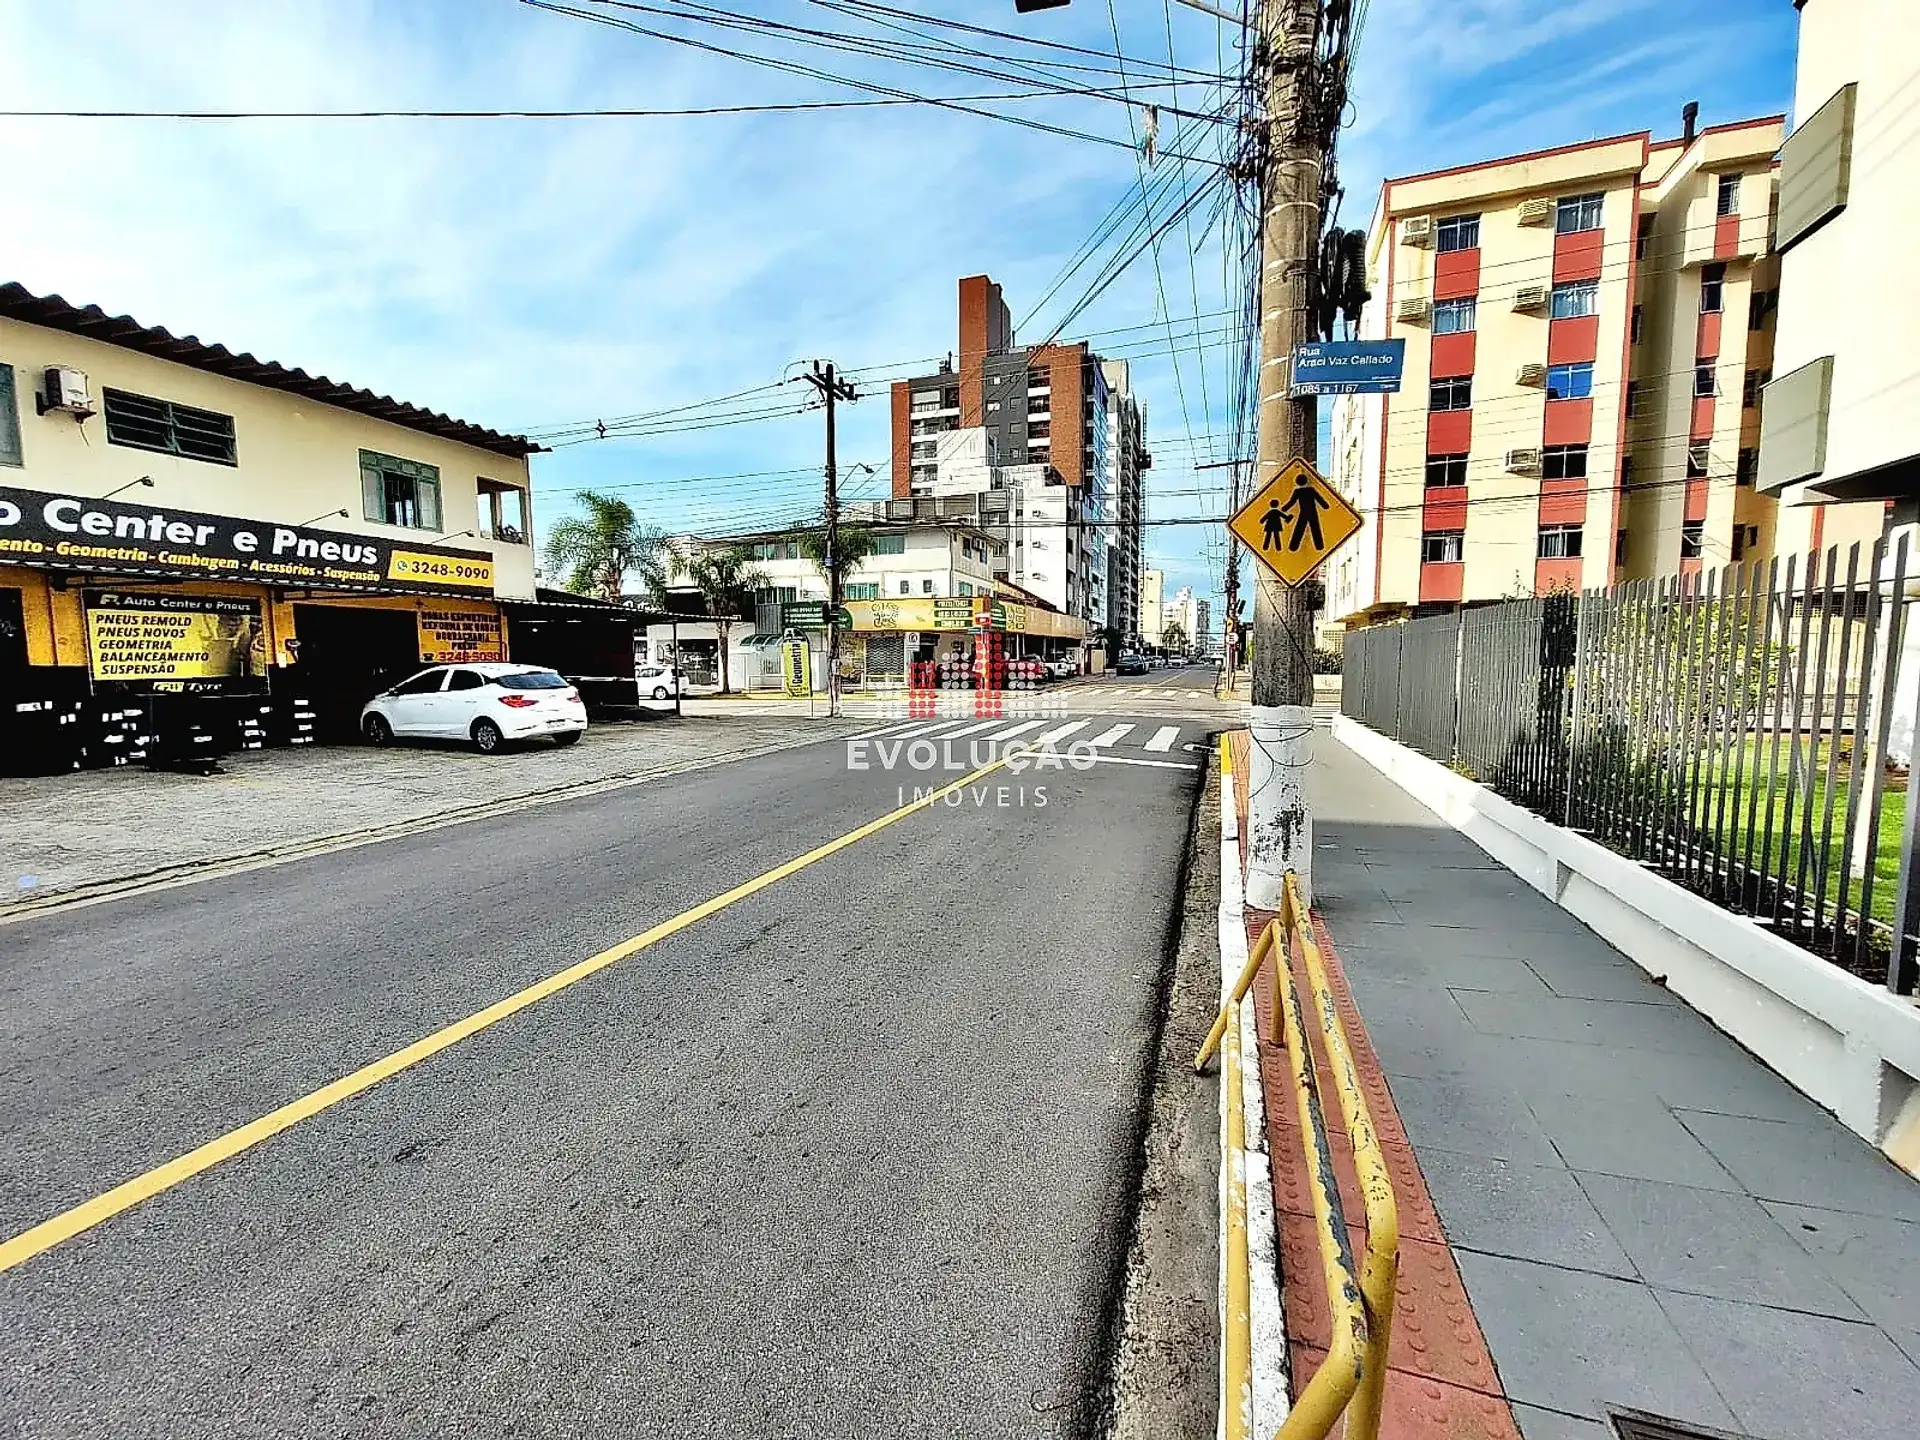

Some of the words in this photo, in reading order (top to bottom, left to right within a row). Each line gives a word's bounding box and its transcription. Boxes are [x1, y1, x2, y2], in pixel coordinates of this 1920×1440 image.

[1299, 347, 1321, 357] Rua
[1298, 357, 1326, 368] Araci
[1328, 356, 1348, 366] Vaz
[1322, 386, 1330, 394] a
[43, 499, 216, 546] Center
[232, 530, 259, 552] e
[272, 527, 378, 565] Pneus
[158, 550, 239, 571] Cambagem
[249, 559, 316, 576] Acessórios
[323, 566, 380, 582] Suspensão
[411, 561, 490, 580] 3248-9090
[123, 596, 156, 606] Auto
[160, 597, 202, 609] Center
[205, 601, 213, 609] e
[216, 601, 251, 611] Pneus
[96, 614, 139, 625] PNEUS
[141, 615, 192, 627] REMOLD
[97, 627, 140, 638] PNEUS
[142, 628, 187, 638] NOVOS
[98, 639, 173, 650] GEOMETRIA
[100, 652, 209, 662] BALANCEAMENTO
[101, 662, 176, 675] SUSPENSÃO
